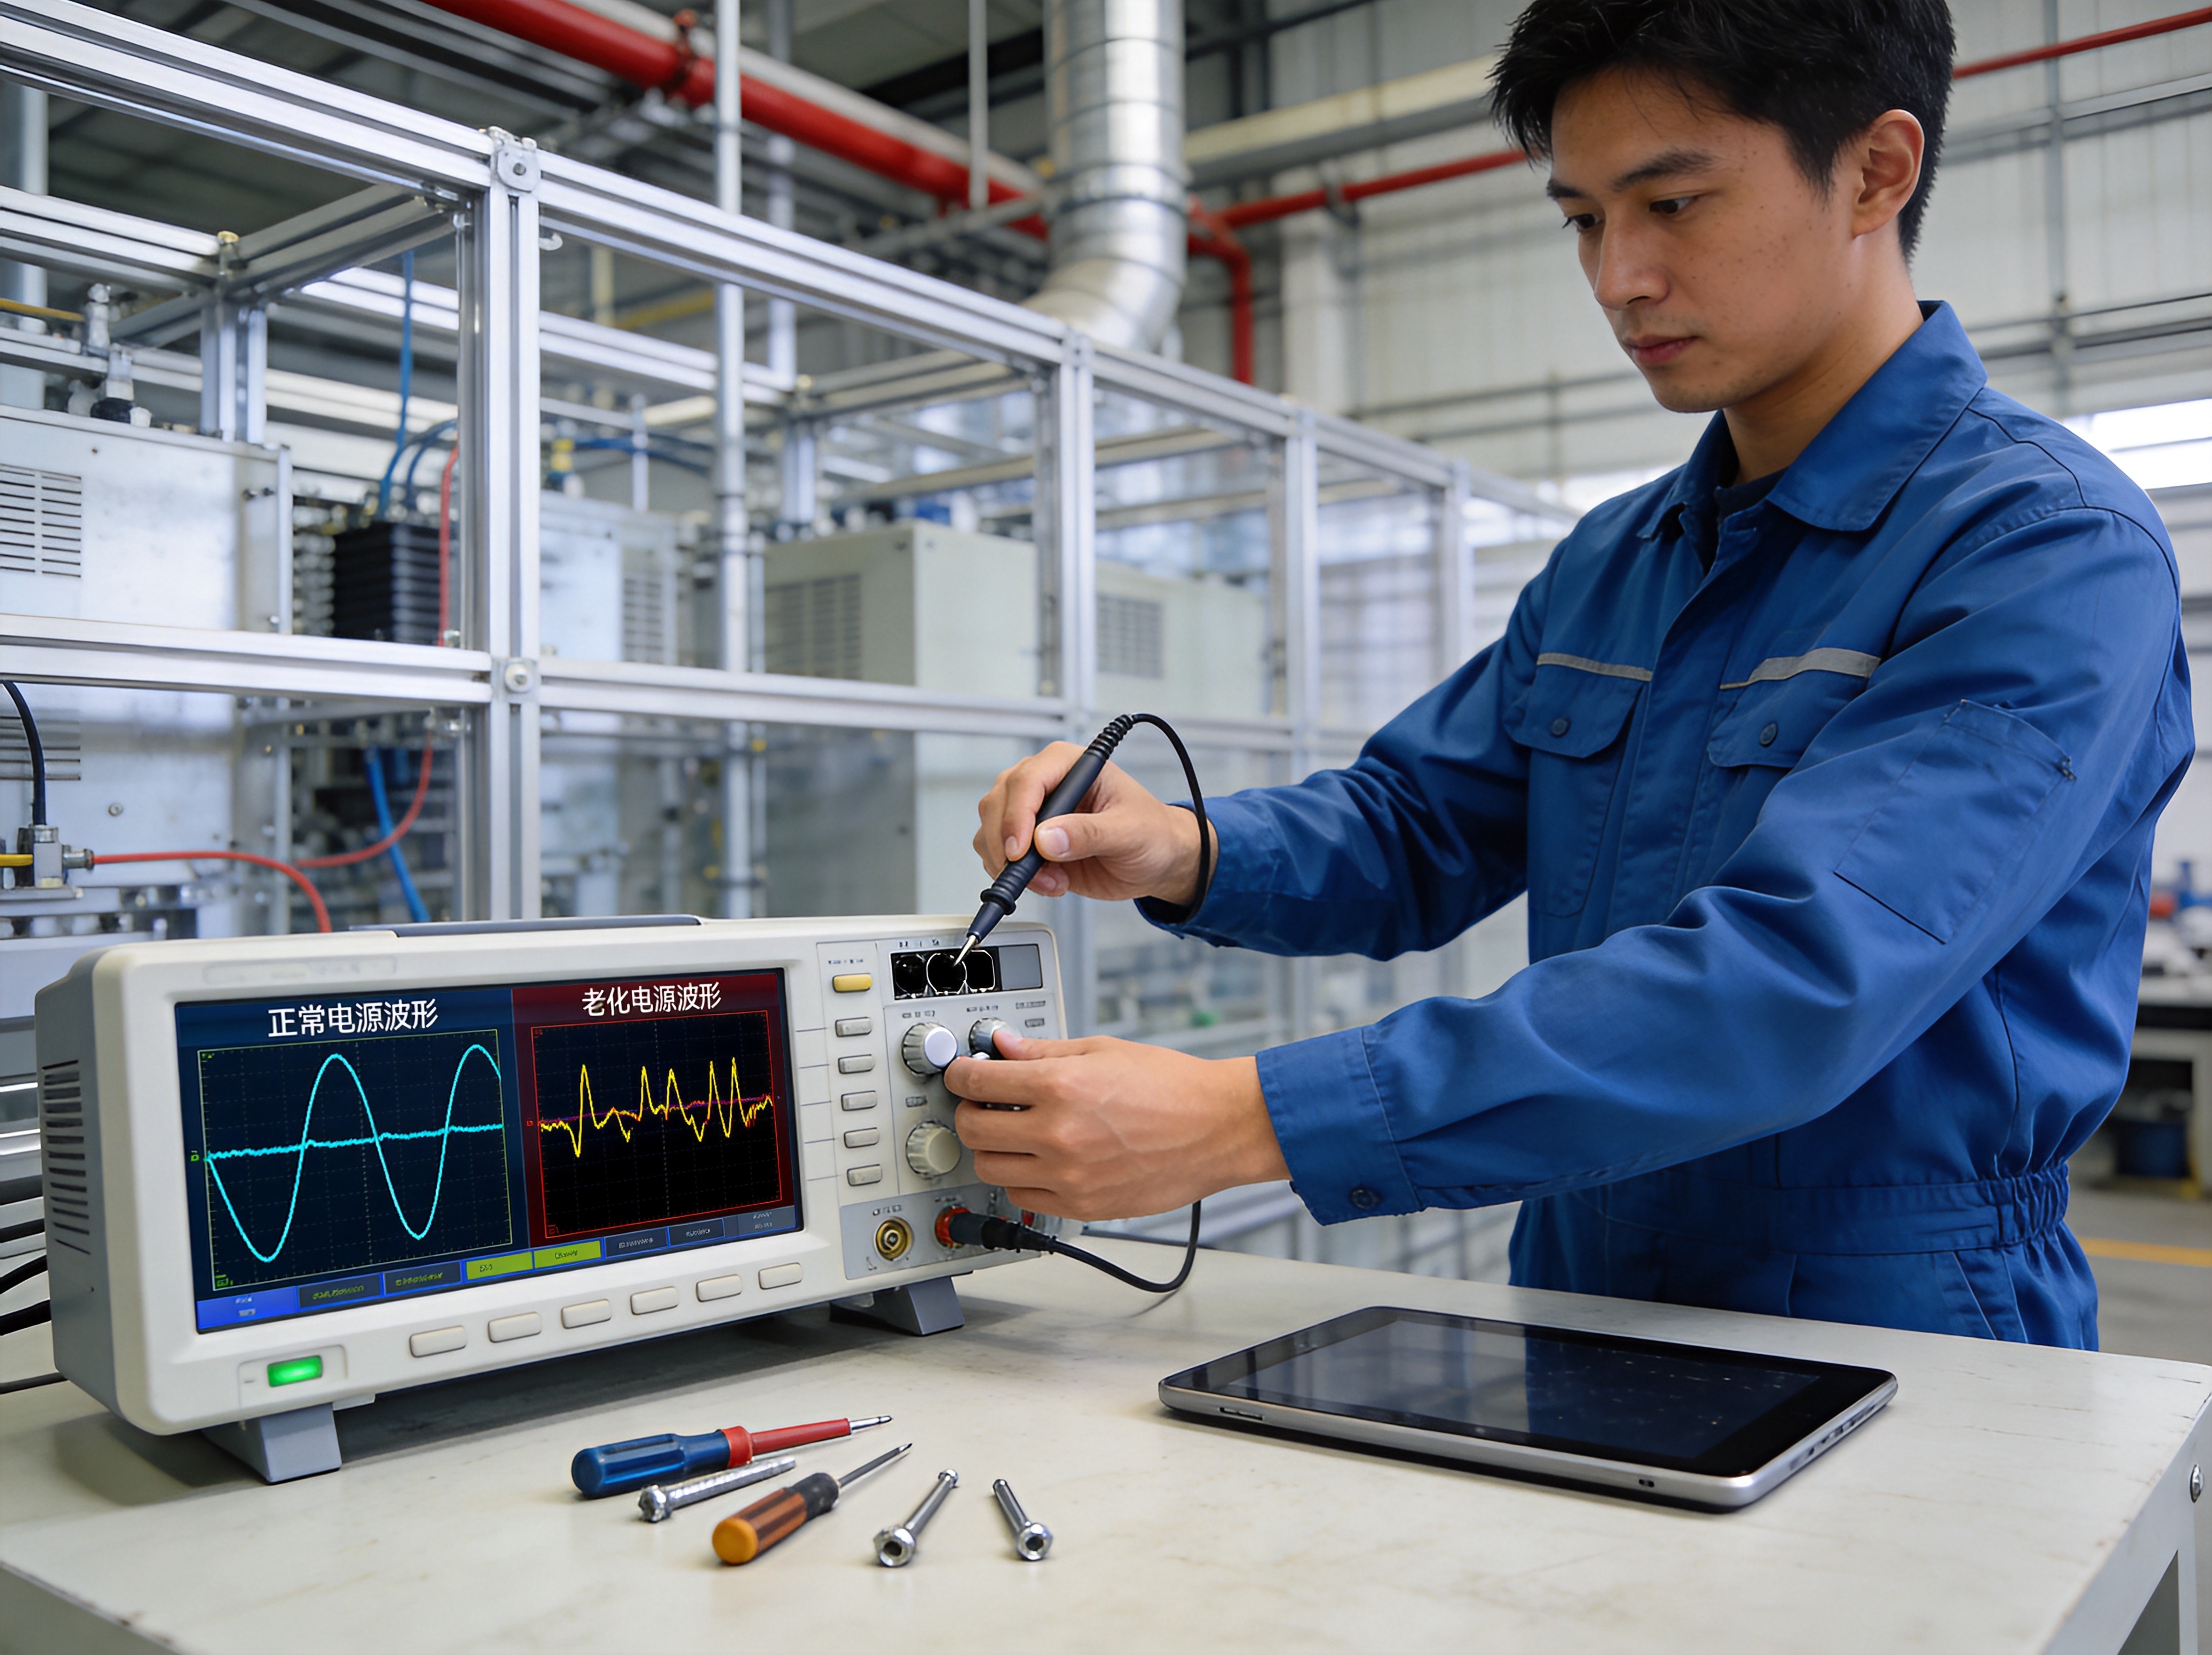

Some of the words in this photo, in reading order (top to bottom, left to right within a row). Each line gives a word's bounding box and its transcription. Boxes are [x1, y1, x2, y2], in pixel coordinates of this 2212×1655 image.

[268, 998, 438, 1037] 正常电源波形
[582, 981, 721, 1017] 老化电源波形
